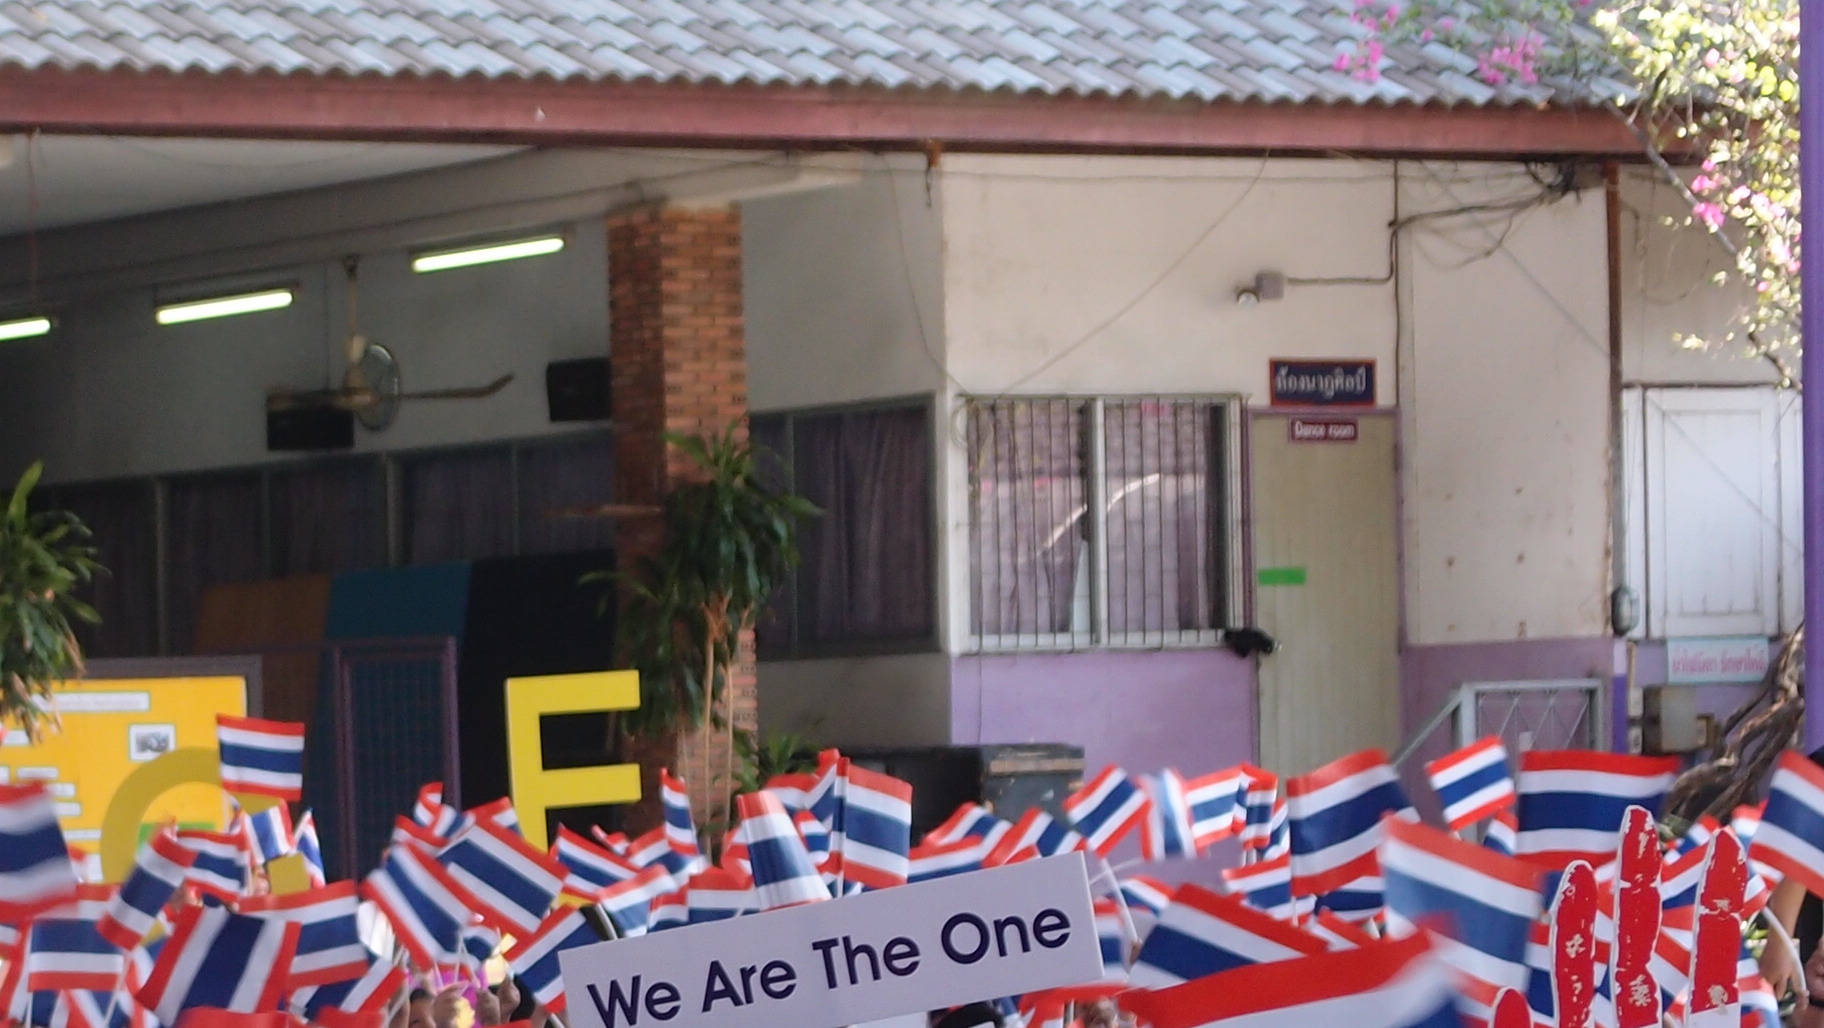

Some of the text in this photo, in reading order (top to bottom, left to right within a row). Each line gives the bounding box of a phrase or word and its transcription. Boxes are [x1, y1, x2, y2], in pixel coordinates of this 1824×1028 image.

[1295, 420, 1355, 439] Dance room
[702, 960, 797, 1012] Are
[812, 935, 920, 989] The
[940, 908, 1071, 965] One
